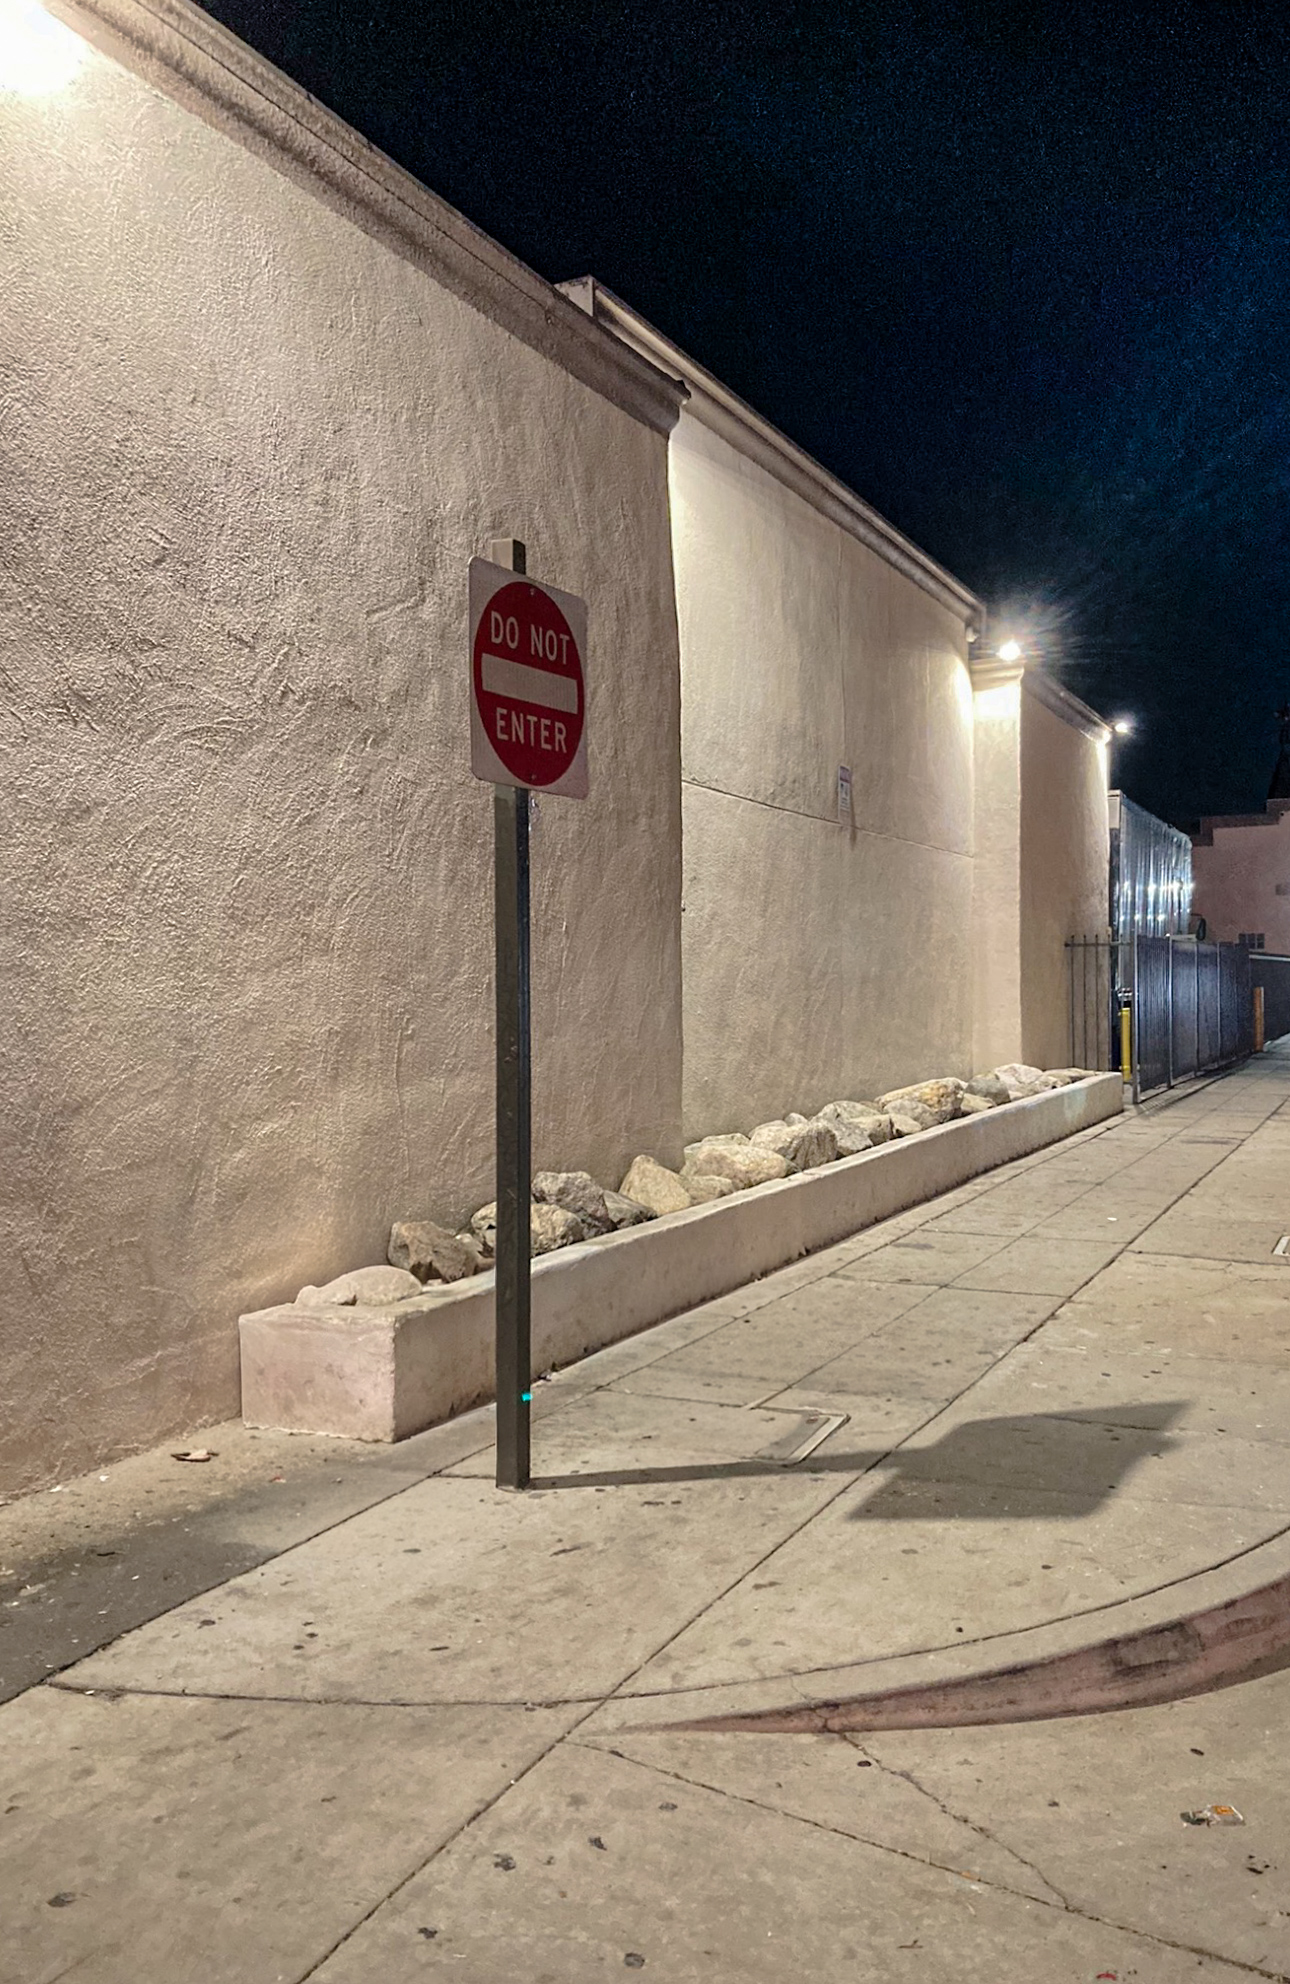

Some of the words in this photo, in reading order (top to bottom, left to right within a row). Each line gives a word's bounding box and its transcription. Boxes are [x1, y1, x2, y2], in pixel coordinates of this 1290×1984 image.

[490, 610, 519, 649] DO
[530, 623, 570, 665] NOT
[495, 707, 567, 754] ENTER
